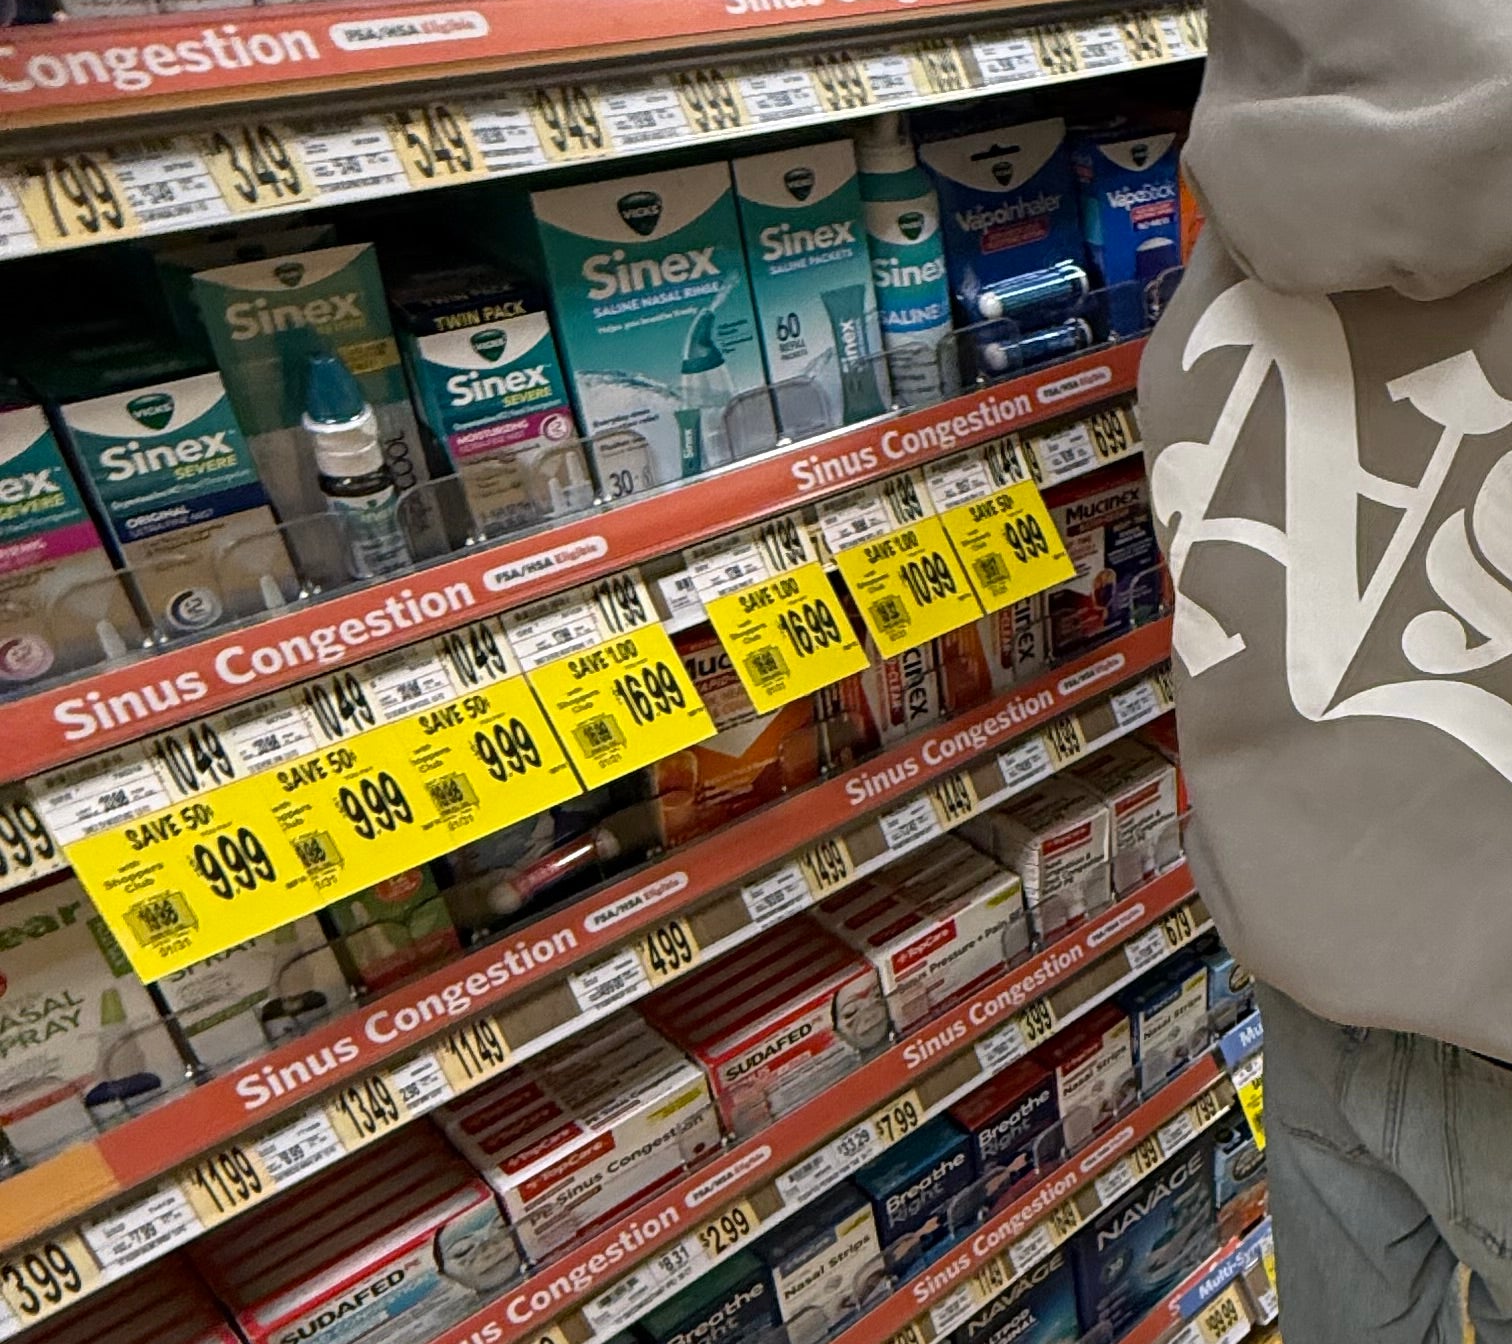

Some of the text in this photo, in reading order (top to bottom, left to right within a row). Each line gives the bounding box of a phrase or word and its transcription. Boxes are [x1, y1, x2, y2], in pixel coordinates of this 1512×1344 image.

[759, 220, 857, 262] Sinex
[581, 245, 721, 301] Sinex
[873, 255, 945, 289] Sinex
[225, 291, 363, 343] Sinex
[434, 299, 528, 332] TWIN PACK
[593, 297, 643, 319] SALINE
[776, 311, 802, 343] 60
[445, 363, 551, 408] Sinex
[503, 386, 553, 409] SEVERE
[101, 430, 233, 482] Sinex
[792, 392, 1033, 492] Sinus Congestion
[174, 453, 237, 481] SEVERE
[609, 469, 635, 498] 30
[125, 506, 191, 530] ORIGINAL
[1065, 487, 1141, 525] Mucinex
[737, 586, 775, 614] SAVE
[52, 541, 600, 742] Sinus Congestion FSA/HSA Eligible
[566, 649, 609, 681] SAVE
[418, 702, 464, 736] SAVE
[845, 689, 1055, 806] Sinus Congestion
[276, 757, 329, 793] SAVE
[125, 814, 182, 852] SAVE
[927, 938, 976, 976] Pressure
[234, 1037, 360, 1112] Sinus
[364, 925, 579, 1045] Congestion
[593, 894, 644, 927] FSA/HSA
[901, 942, 1085, 1071] Sinus Congestion
[723, 1022, 813, 1083] SUDAFED
[977, 1089, 1052, 1149] Breathe
[605, 1112, 708, 1175] Congestion
[885, 1152, 967, 1214] Breathe
[913, 1256, 972, 1305] Sinus
[972, 1170, 1080, 1257] Congestion
[505, 1204, 683, 1327] Congestion
[783, 1234, 873, 1301] Nasal Strips
